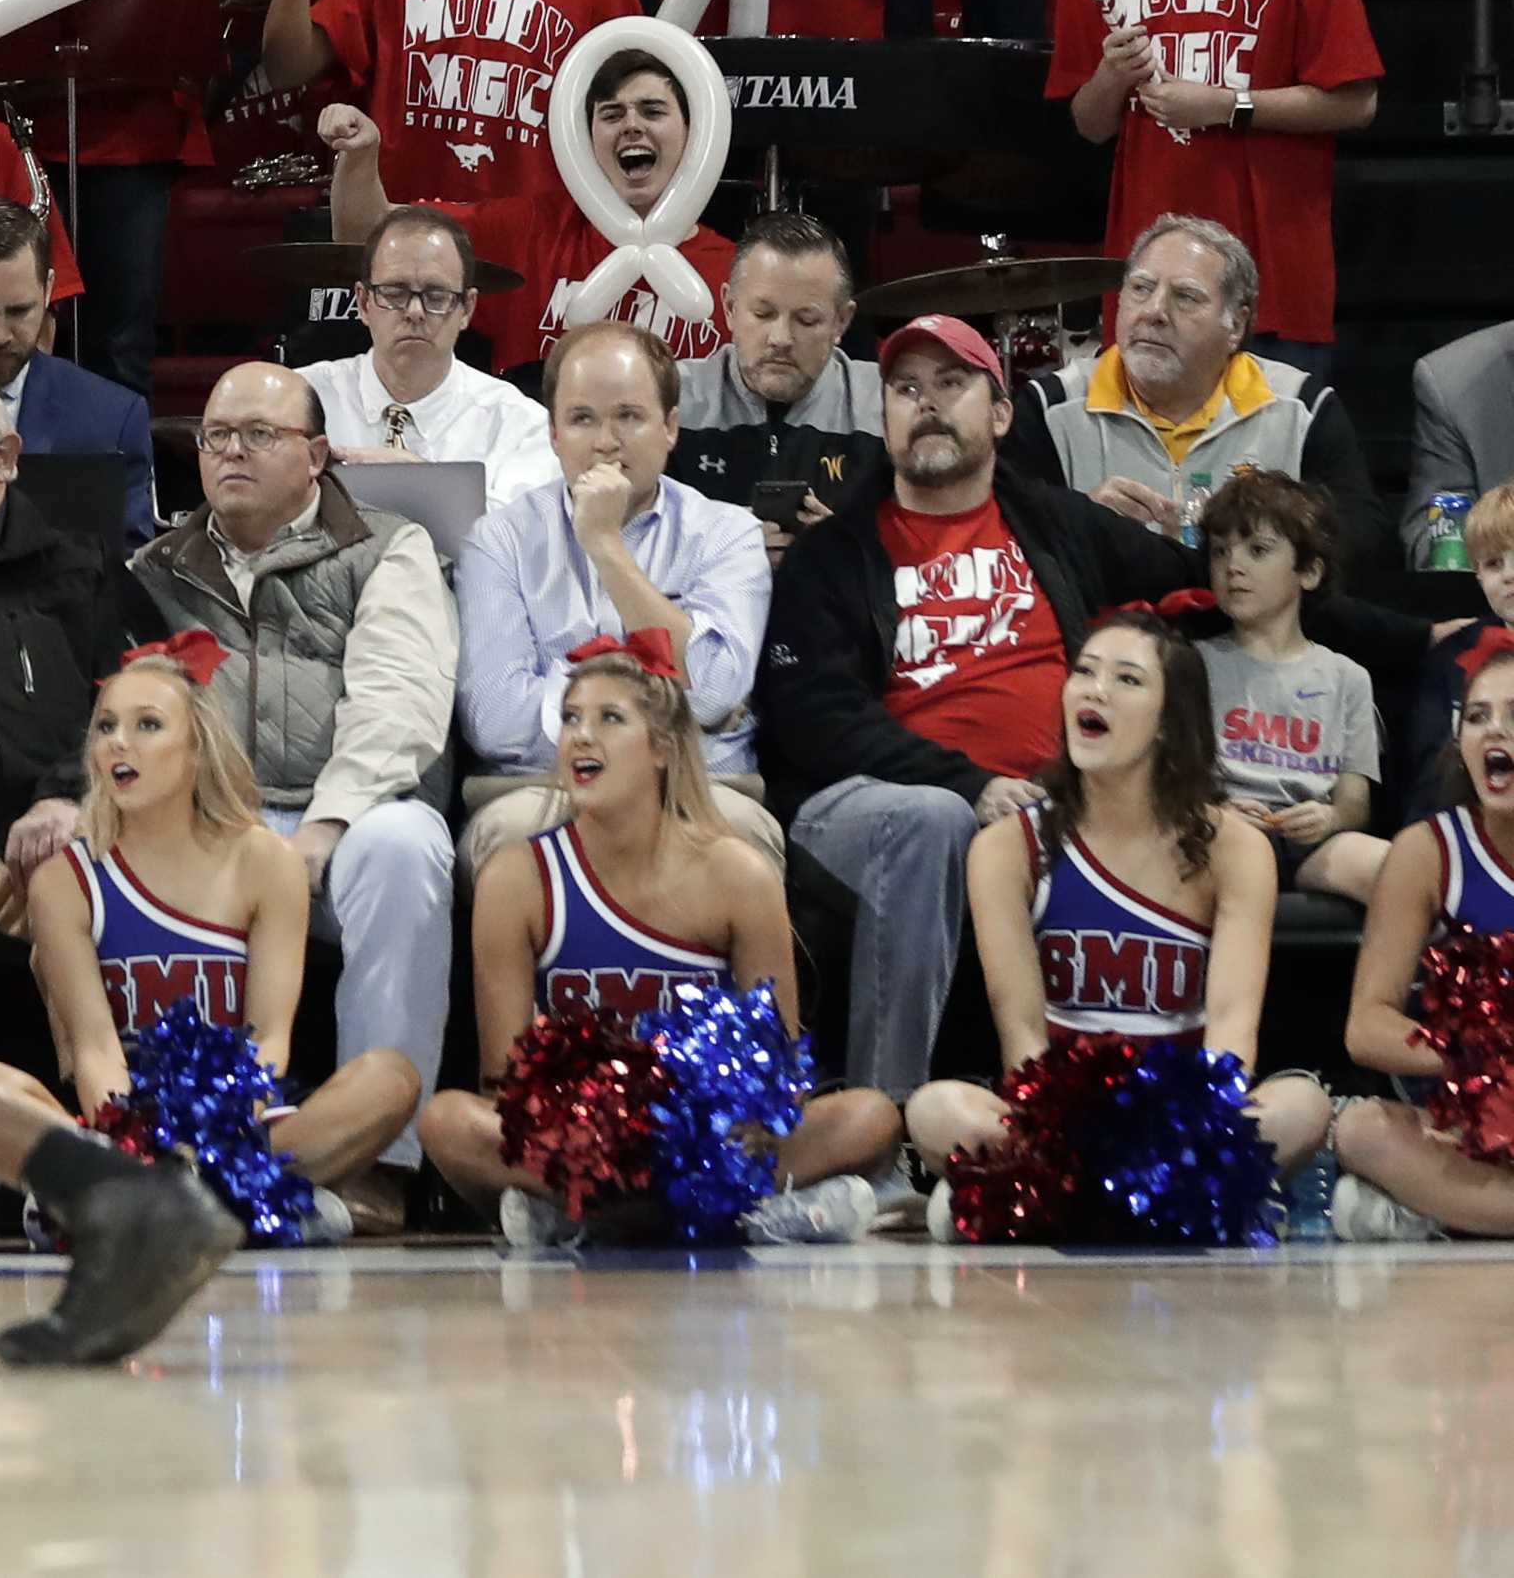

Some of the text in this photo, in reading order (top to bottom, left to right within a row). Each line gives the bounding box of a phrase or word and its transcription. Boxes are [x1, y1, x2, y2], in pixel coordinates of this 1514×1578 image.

[1149, 30, 1258, 90] AGIC
[406, 52, 554, 127] MAGIC
[741, 75, 858, 110] TAMA
[405, 111, 540, 148] STRIPE OUT
[1223, 706, 1321, 754] SMU
[1037, 929, 1209, 1012] SMU
